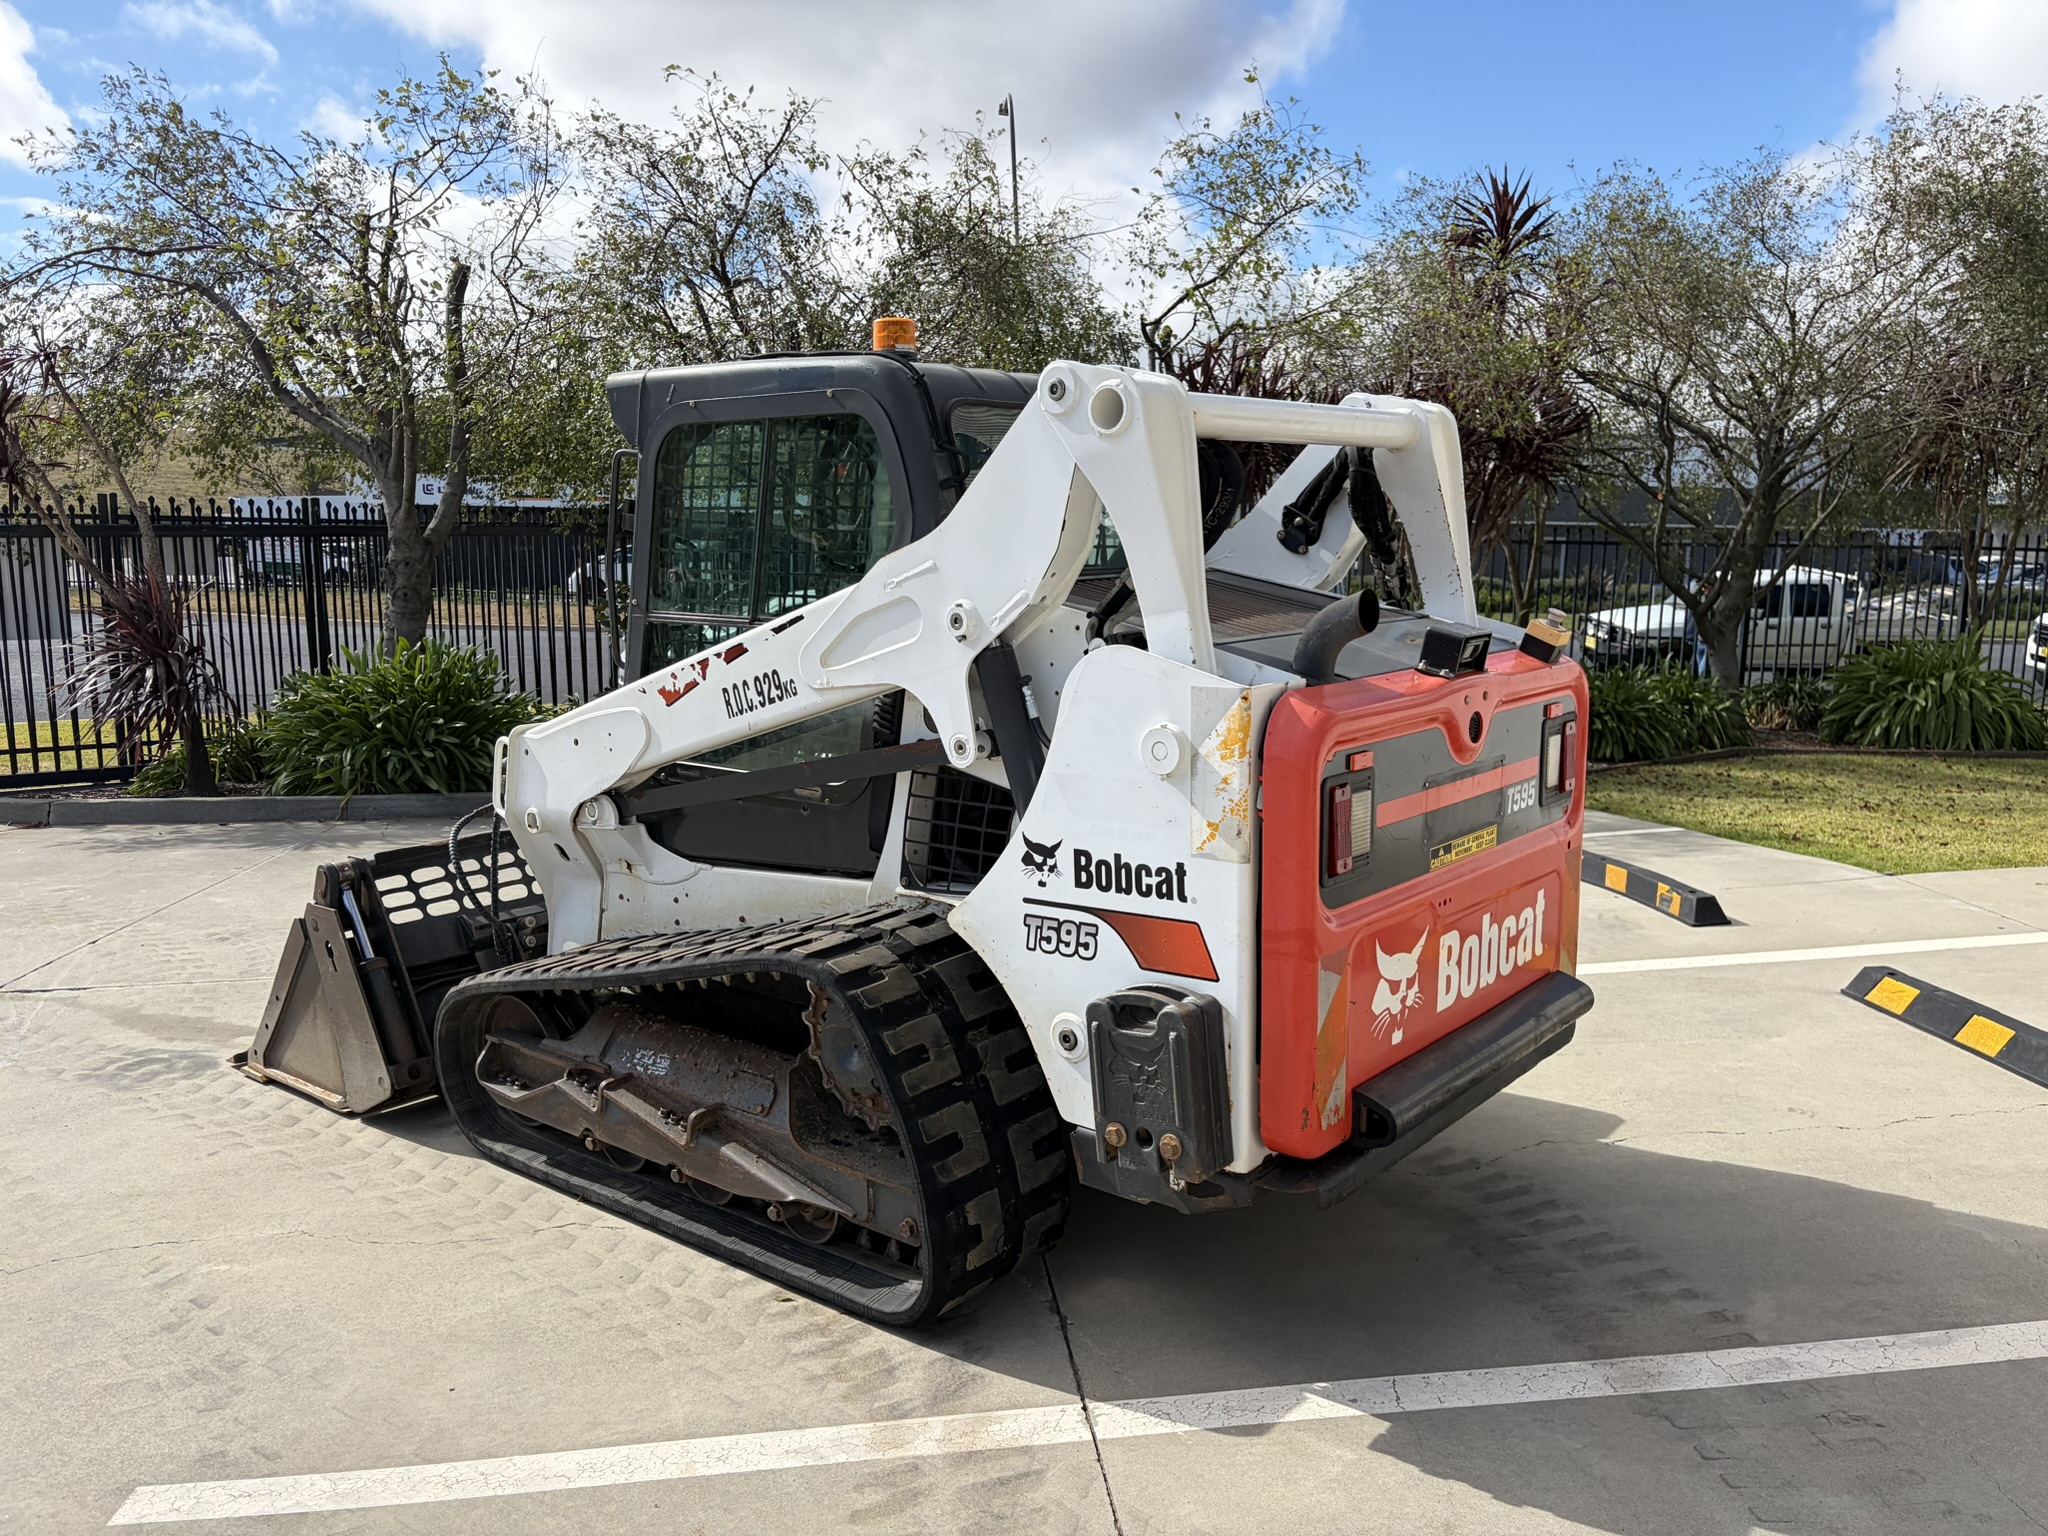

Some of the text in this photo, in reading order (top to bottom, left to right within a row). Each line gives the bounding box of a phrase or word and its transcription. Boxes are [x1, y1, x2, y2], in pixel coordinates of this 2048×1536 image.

[1507, 780, 1536, 814] T595
[1073, 848, 1188, 904] Bobcat
[1431, 853, 1452, 870] CAUTION
[1023, 913, 1099, 961] T595
[1437, 888, 1545, 1013] Bobcat
